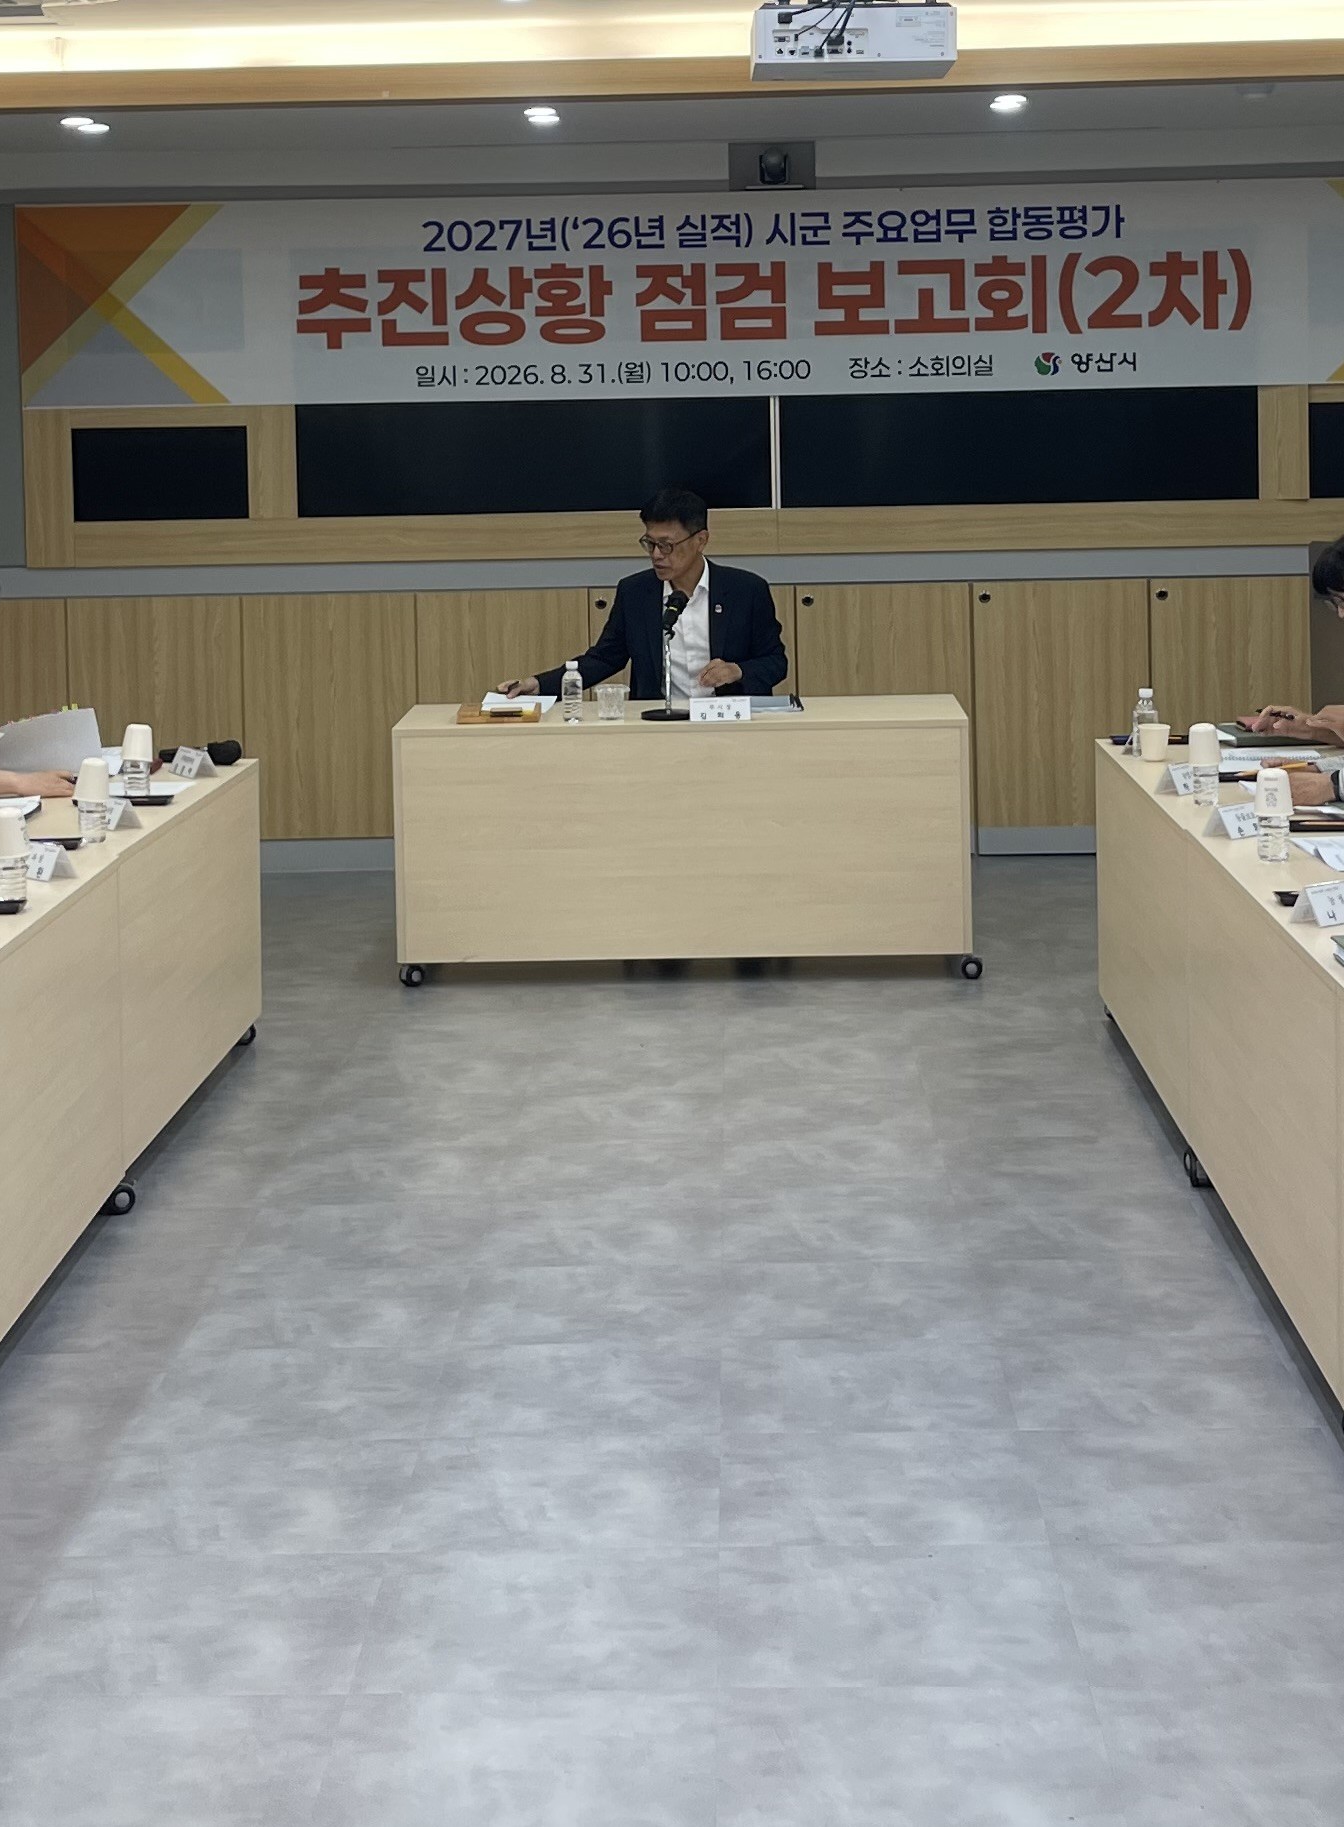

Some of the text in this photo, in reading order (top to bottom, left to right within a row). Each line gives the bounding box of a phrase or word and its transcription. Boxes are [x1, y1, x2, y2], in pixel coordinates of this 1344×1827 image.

[676, 212, 753, 249] 실적)
[765, 211, 832, 246] 시군
[841, 208, 977, 246] 주요업무
[986, 204, 1125, 242] 합동평가
[296, 248, 1253, 349] 추진상황 점검 보고회(2차)
[474, 364, 545, 386] 2026.
[550, 363, 572, 385] 8.
[578, 360, 652, 385] 31.(월)
[660, 360, 735, 385] 10:00,
[742, 359, 811, 381] 16:00
[908, 353, 995, 378] 소회의실
[1069, 351, 1138, 375] 양산시
